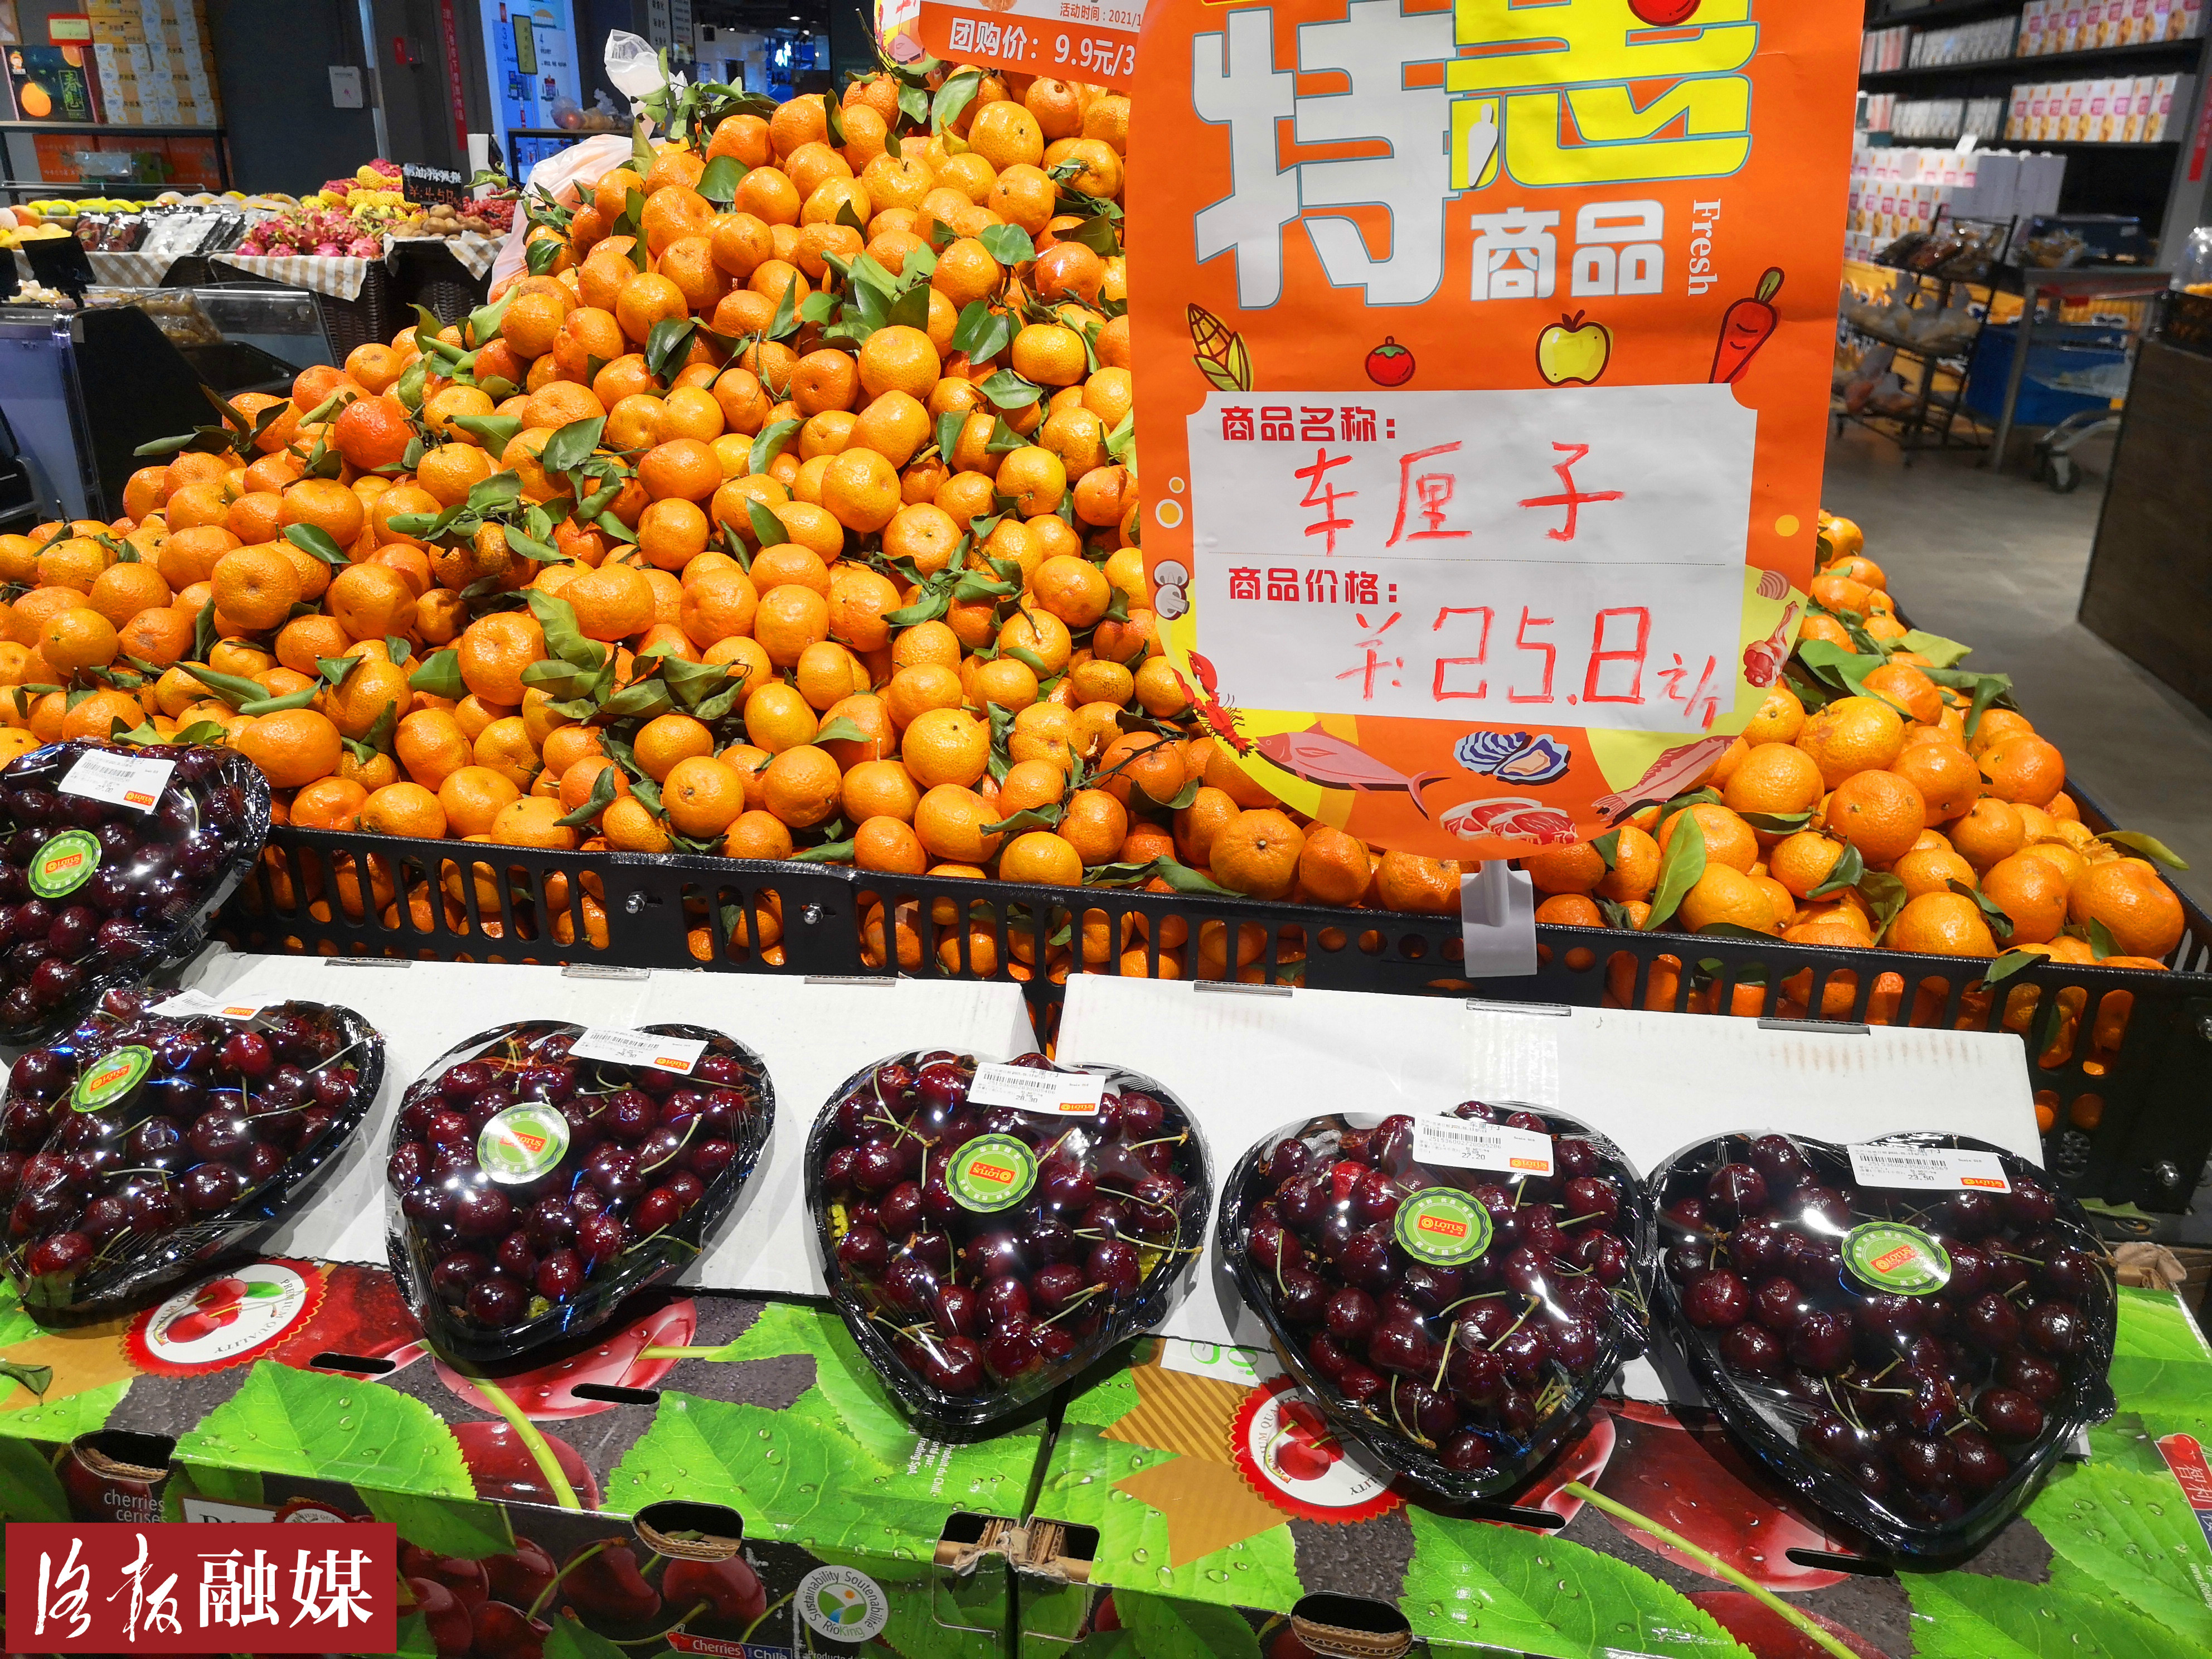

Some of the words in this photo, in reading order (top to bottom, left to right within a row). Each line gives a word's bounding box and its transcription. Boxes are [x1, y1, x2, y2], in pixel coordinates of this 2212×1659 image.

[1470, 198, 1665, 302] 商品
[1687, 198, 1721, 297] Fresh
[1220, 406, 1396, 443] 商品名称：
[1294, 440, 1627, 557] 车厘子
[1228, 566, 1398, 605] 商品价格：
[134, 794, 153, 802] LOTUS
[57, 856, 80, 866] LOTUS
[666, 1059, 688, 1068] LOTUS
[973, 1167, 999, 1178] LOTUS
[1522, 1160, 1548, 1168] LOTUS
[1434, 1220, 1463, 1232] LOTUS
[1885, 1249, 1912, 1263] LOTUS
[214, 1320, 276, 1354] QUALITY
[910, 1438, 929, 1460] Trading
[940, 1443, 955, 1467] Produit
[936, 1467, 947, 1476] du
[104, 1488, 165, 1512] cherries
[116, 1507, 167, 1522] cerises
[804, 1570, 840, 1621] Sustainability
[692, 1639, 741, 1656] Cherries
[754, 1648, 787, 1659] Chile
